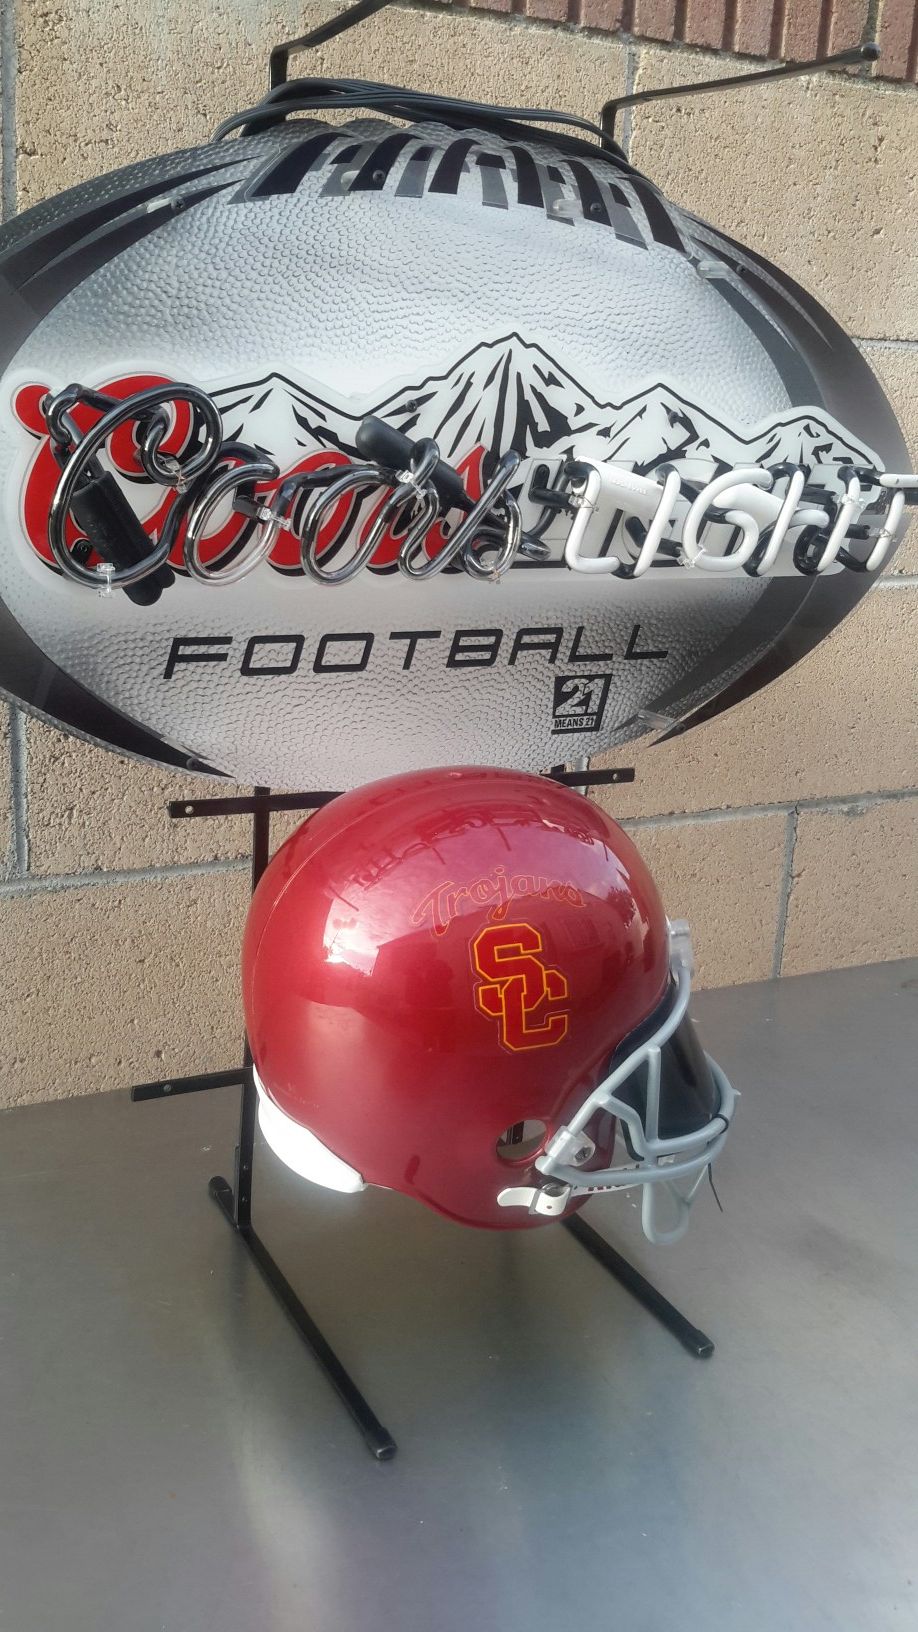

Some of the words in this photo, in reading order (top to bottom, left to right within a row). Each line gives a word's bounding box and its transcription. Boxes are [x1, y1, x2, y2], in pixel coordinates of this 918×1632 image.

[12, 373, 523, 585] Coors
[163, 624, 669, 680] FOOTBALL
[554, 717, 584, 728] MEANS
[585, 717, 594, 727] 21
[555, 678, 605, 715] 21
[410, 866, 587, 936] Trojans
[473, 922, 569, 1052] SC
